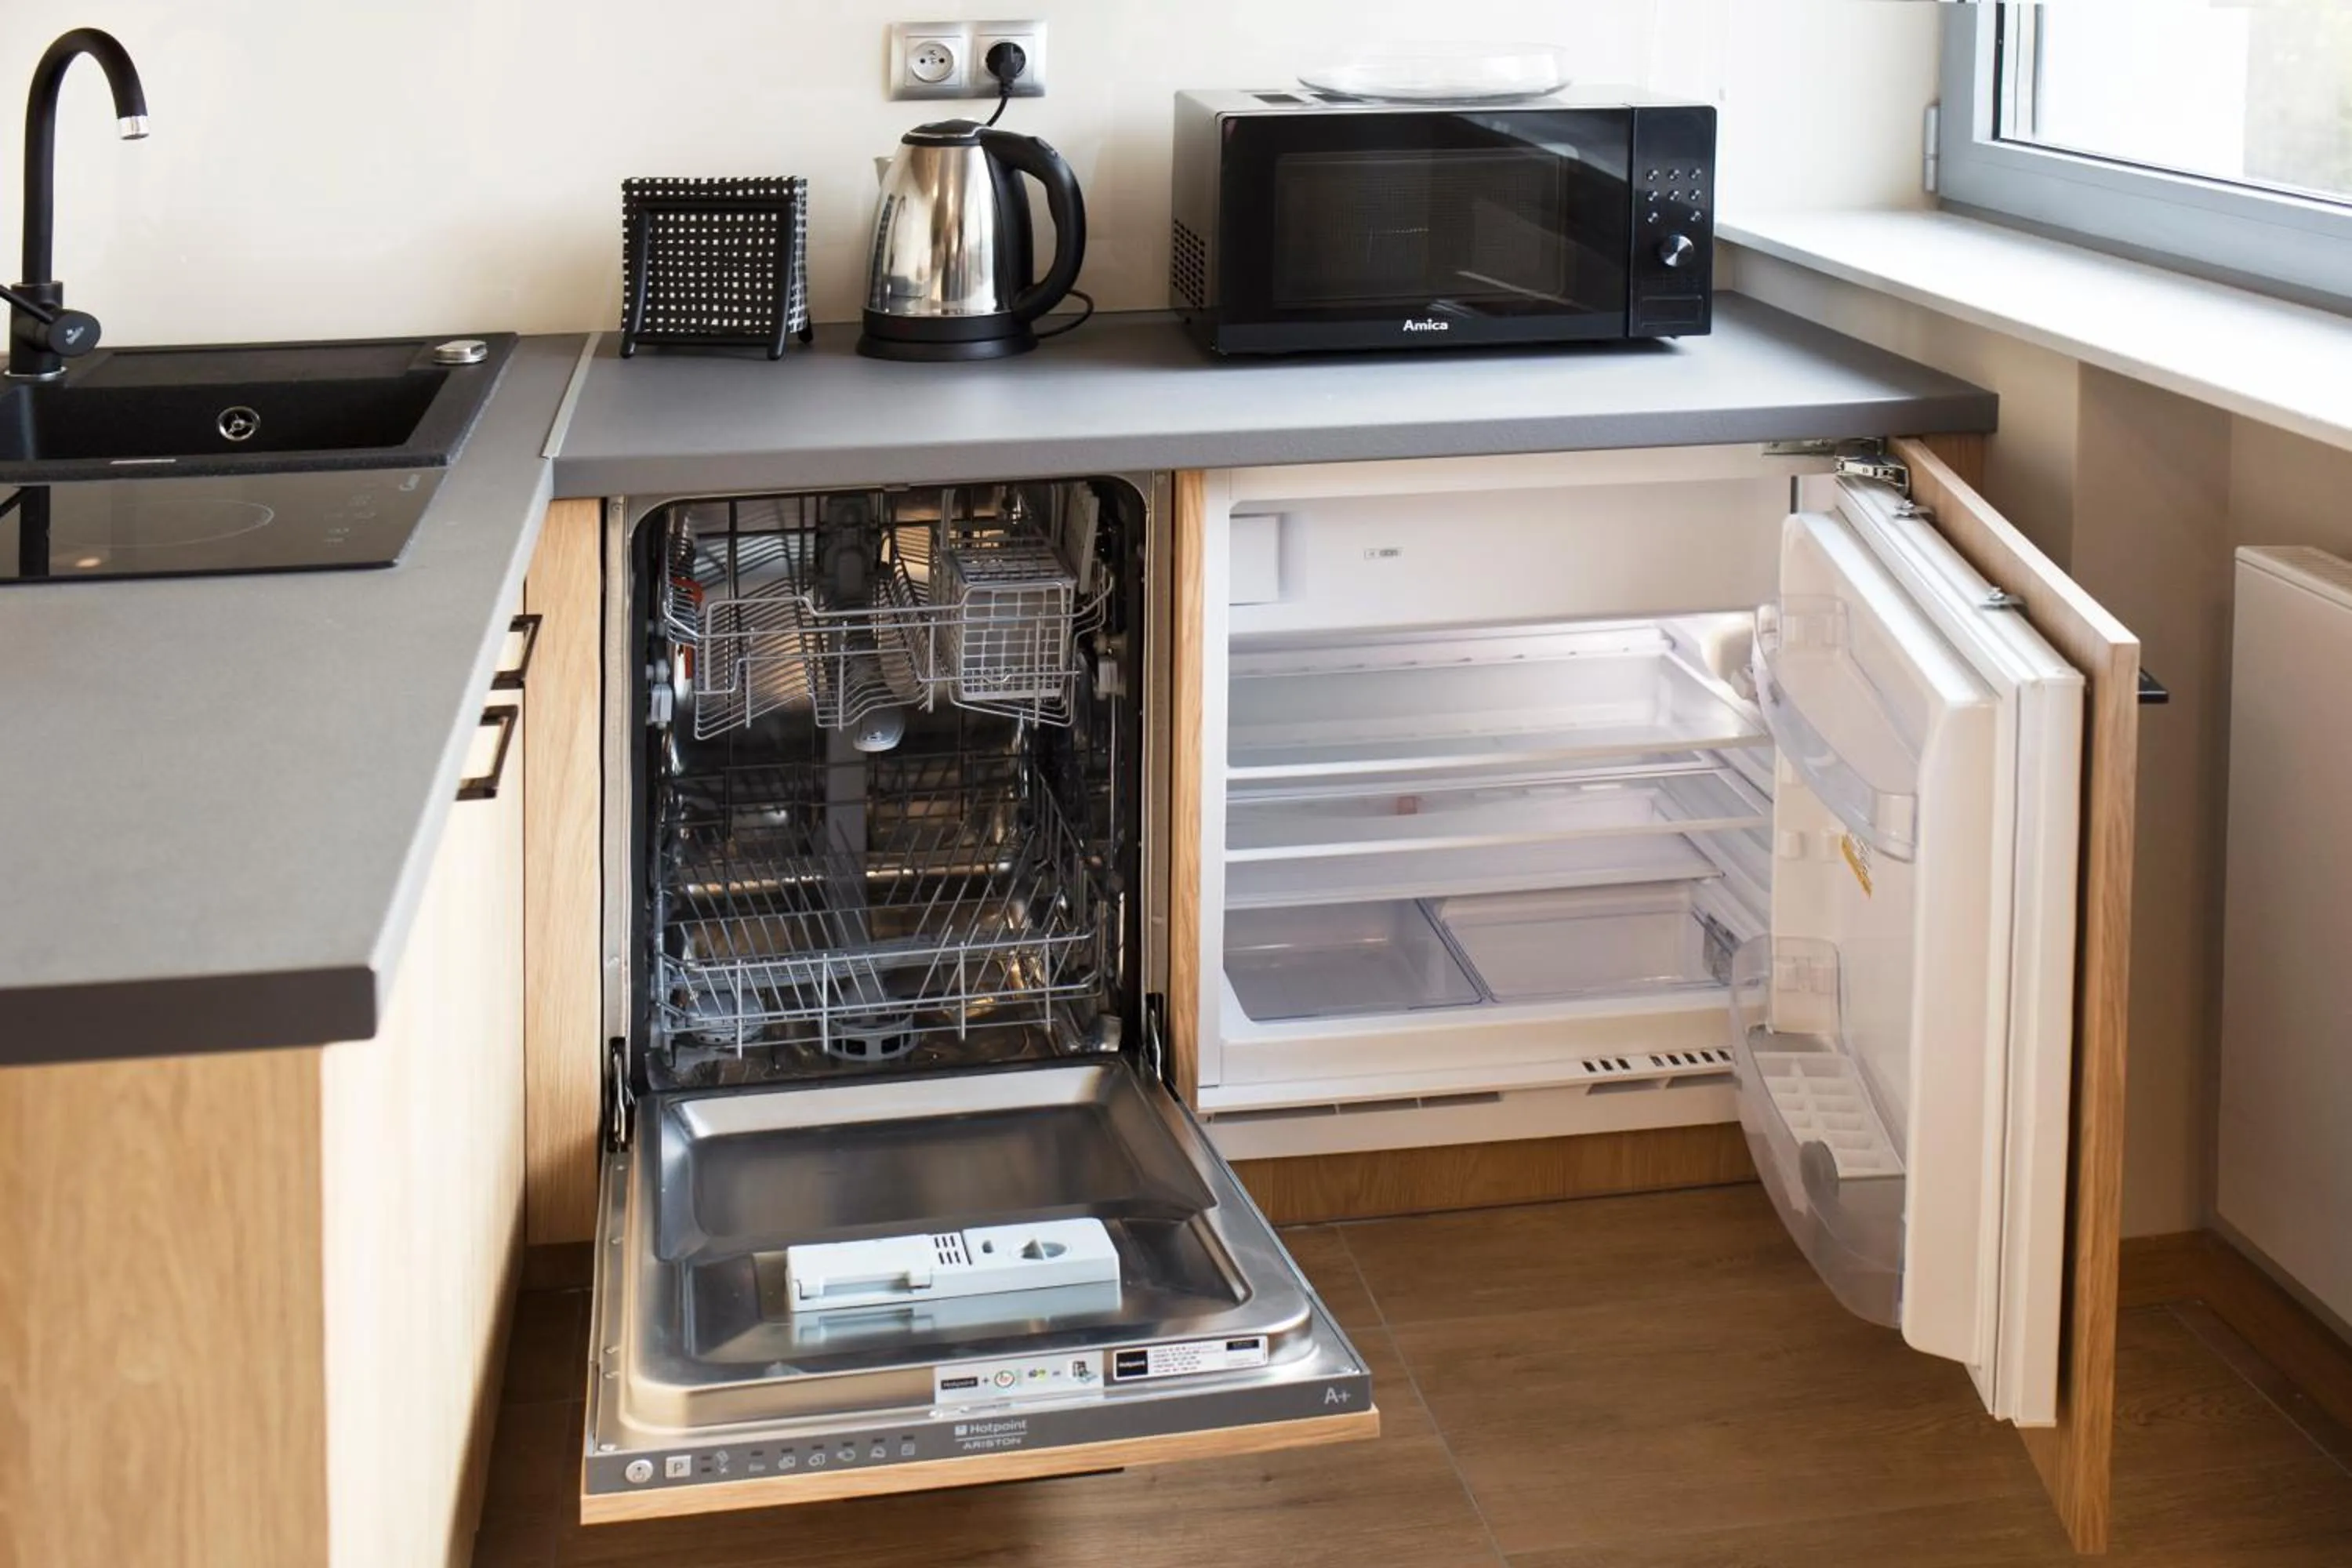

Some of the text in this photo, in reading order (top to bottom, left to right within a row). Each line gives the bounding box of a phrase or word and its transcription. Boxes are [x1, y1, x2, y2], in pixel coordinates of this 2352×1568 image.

[1403, 318, 1448, 332] Amica
[1324, 1387, 1351, 1404] A+
[970, 1419, 1027, 1435] Hotpoint
